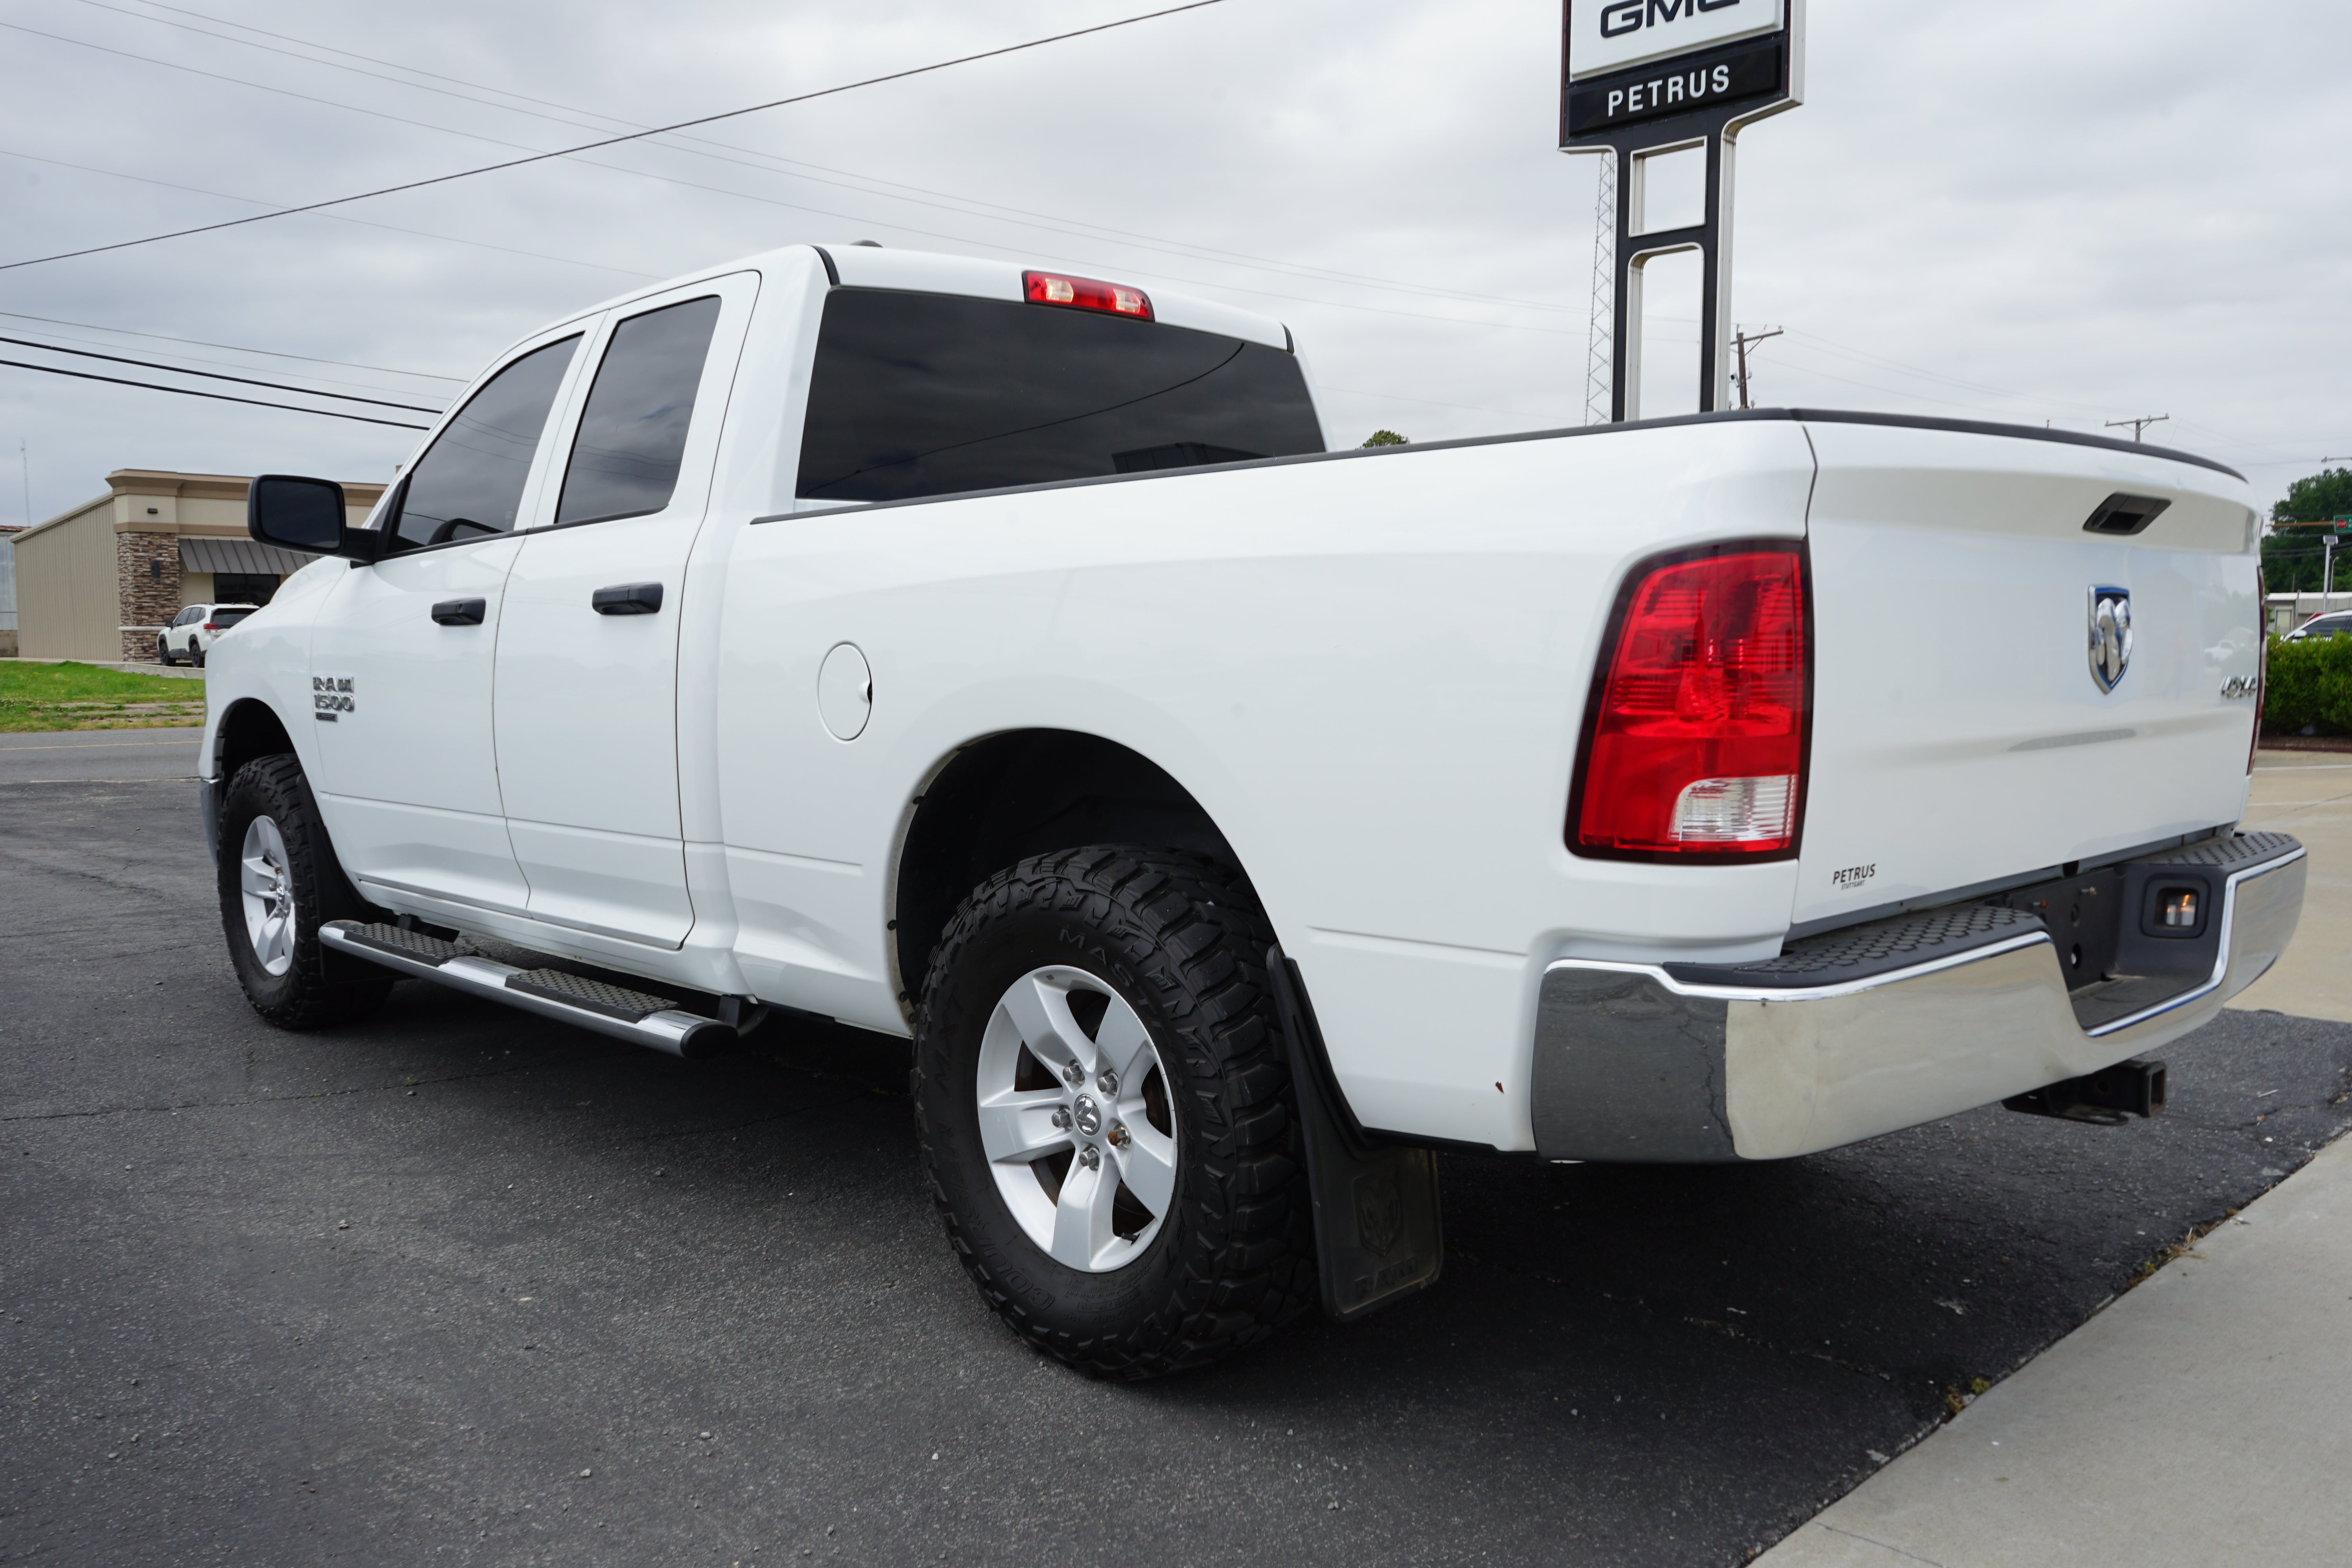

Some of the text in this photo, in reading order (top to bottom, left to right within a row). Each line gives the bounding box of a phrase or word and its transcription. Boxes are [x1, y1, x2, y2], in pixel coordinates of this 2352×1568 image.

[1600, 0, 1740, 38] GM
[1608, 65, 1730, 117] PETRUS
[313, 676, 354, 693] RAM
[314, 694, 355, 712] 1500
[1833, 863, 1876, 884] PETRUS
